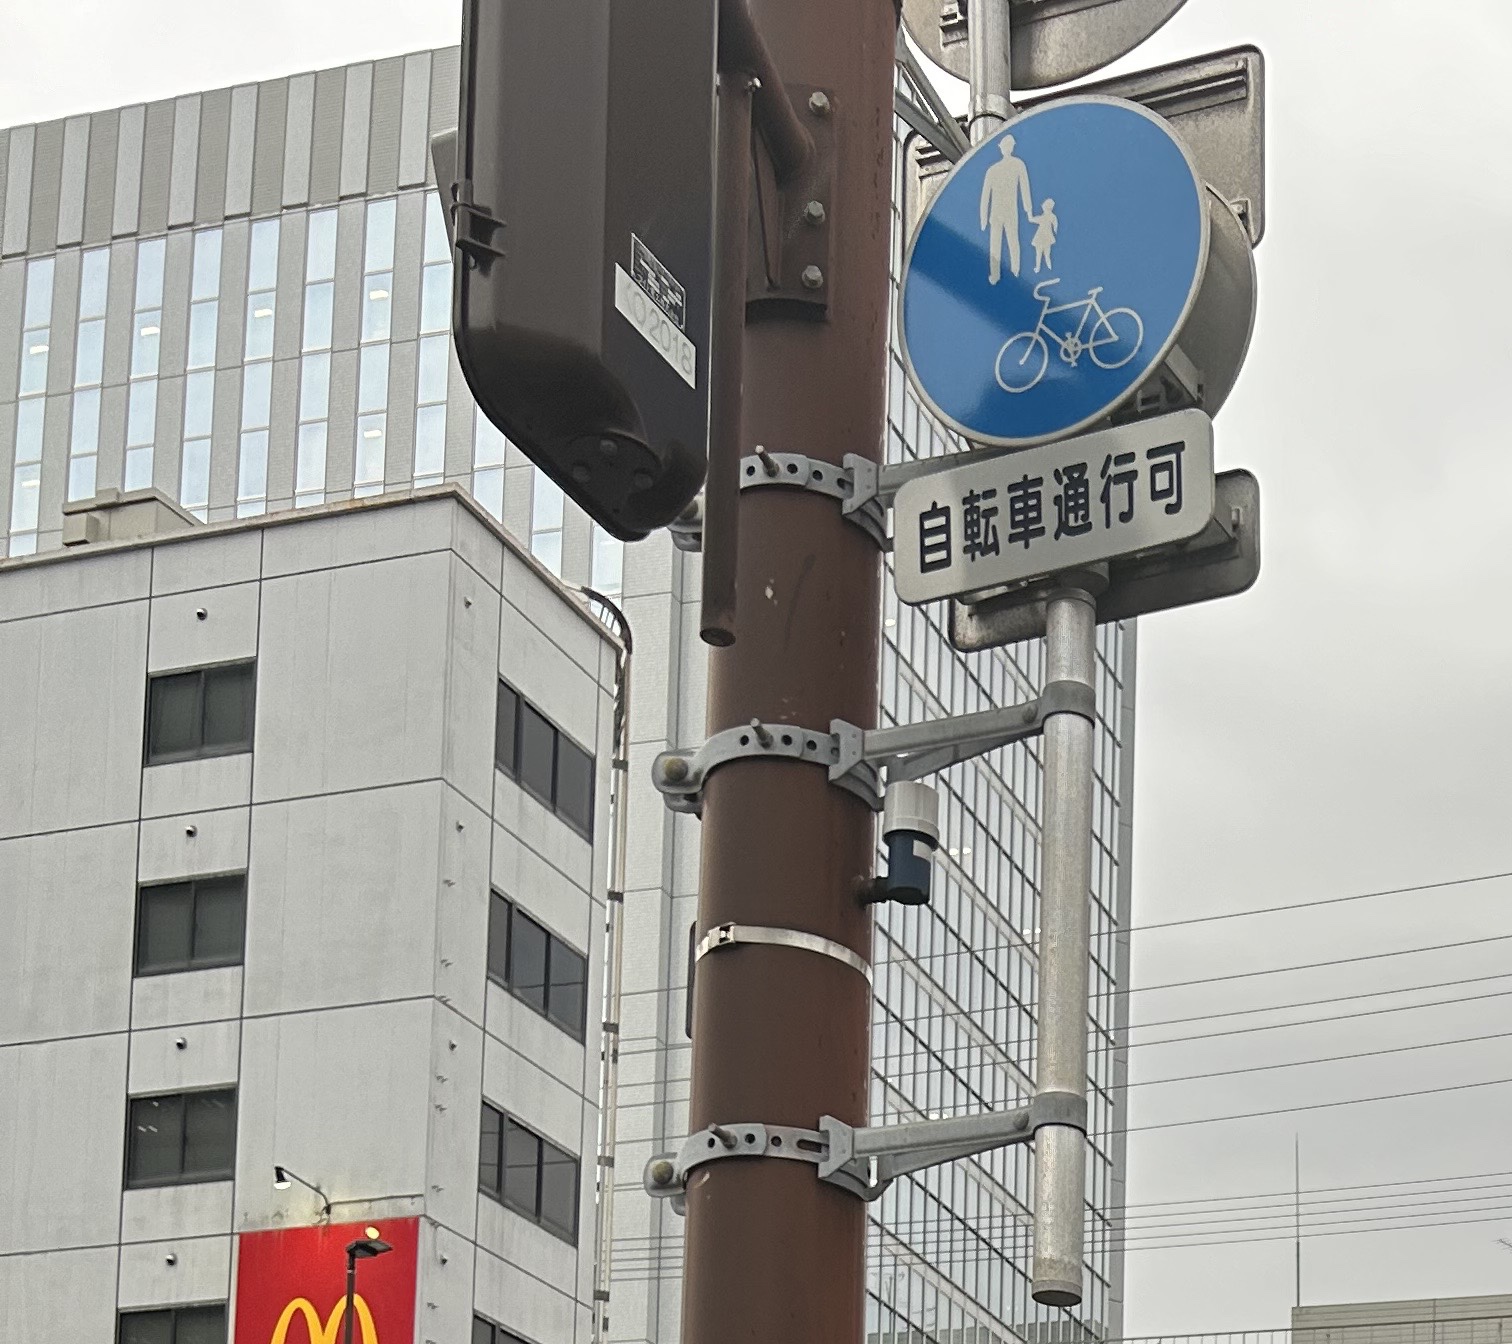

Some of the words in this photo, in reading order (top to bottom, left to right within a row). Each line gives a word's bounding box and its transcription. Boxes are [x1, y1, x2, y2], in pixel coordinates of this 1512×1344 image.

[919, 441, 1186, 574] 自転車通行可
